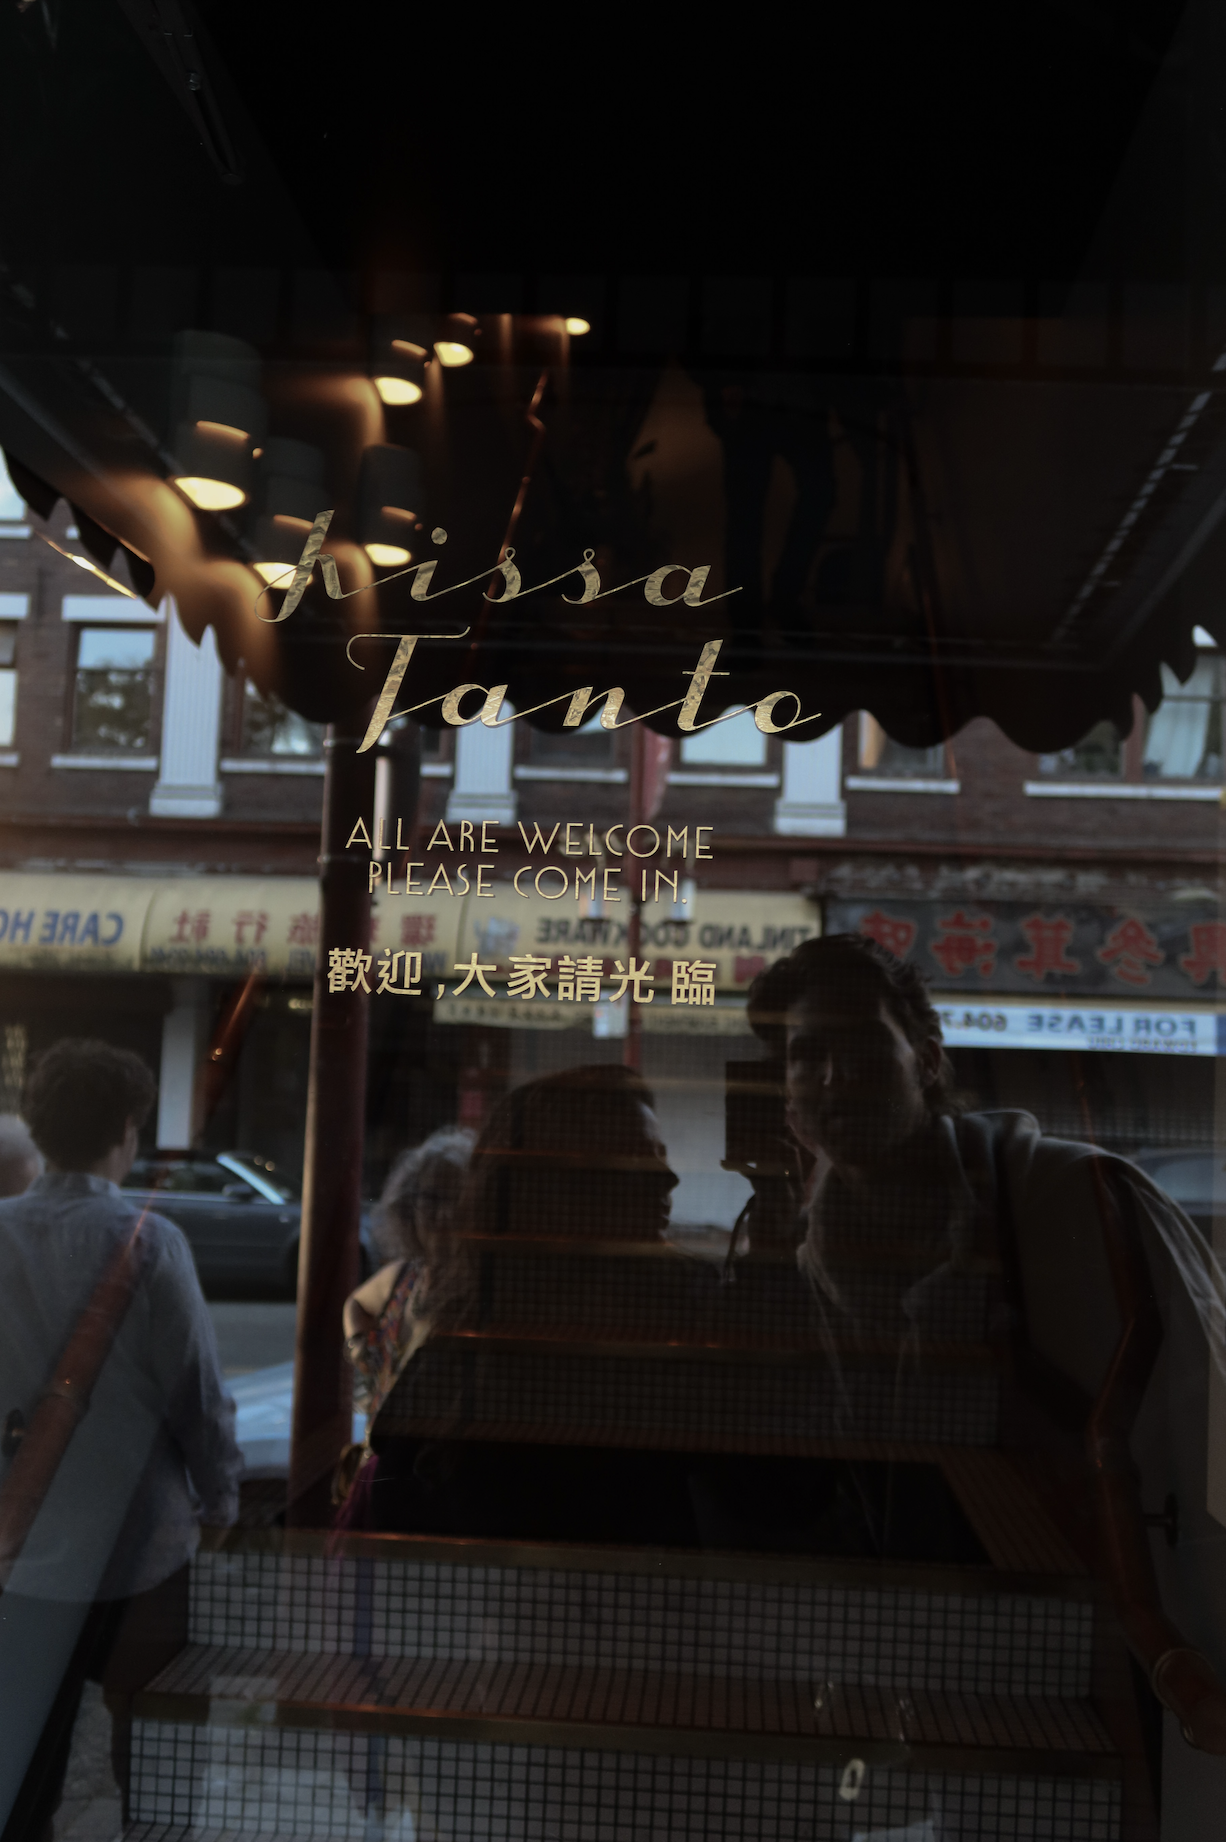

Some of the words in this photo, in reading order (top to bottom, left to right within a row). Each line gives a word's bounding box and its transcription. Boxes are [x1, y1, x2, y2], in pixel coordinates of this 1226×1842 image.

[346, 625, 823, 754] Tanto
[344, 815, 409, 852] ALL
[426, 818, 500, 854] ARE
[517, 821, 715, 860] WELCOME
[367, 860, 496, 899] PLEASE
[512, 864, 622, 903] COME
[640, 868, 689, 905] IN.
